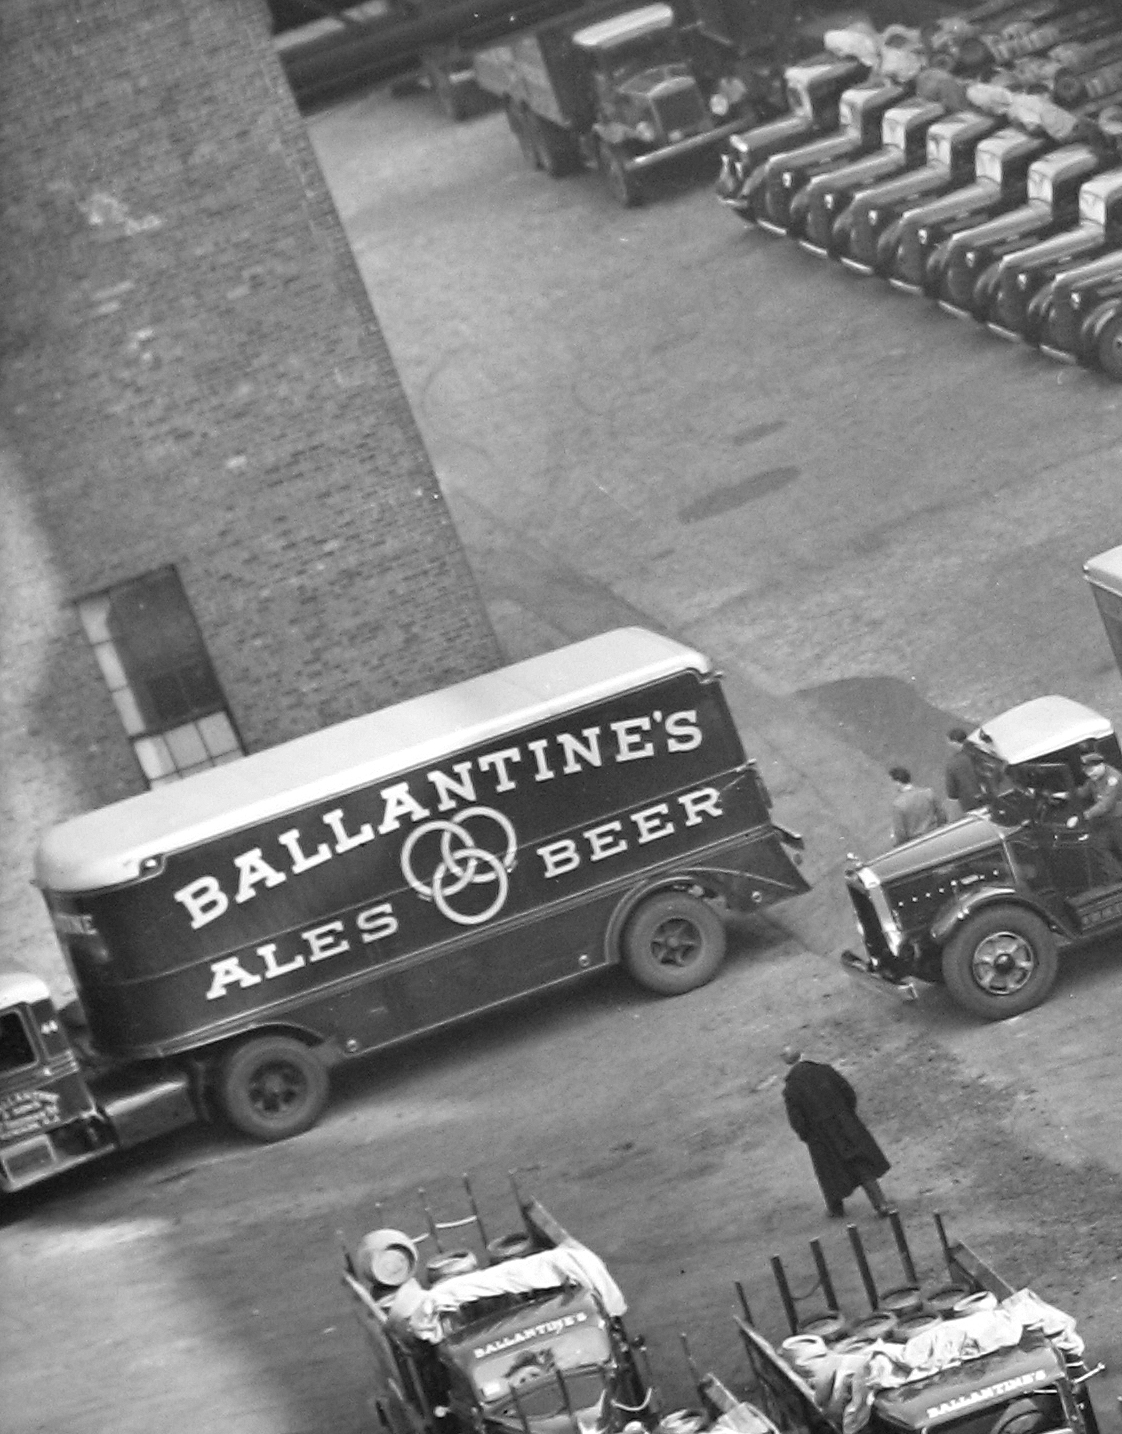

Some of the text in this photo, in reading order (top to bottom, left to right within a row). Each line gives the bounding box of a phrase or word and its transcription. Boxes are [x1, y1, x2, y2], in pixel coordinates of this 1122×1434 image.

[173, 709, 703, 930] BALLANTINE'S
[536, 786, 724, 879] BEER
[204, 903, 399, 1001] ALES
[474, 1312, 588, 1359] BALLANTINE'S
[926, 1369, 1047, 1419] BALLANTINE'S
